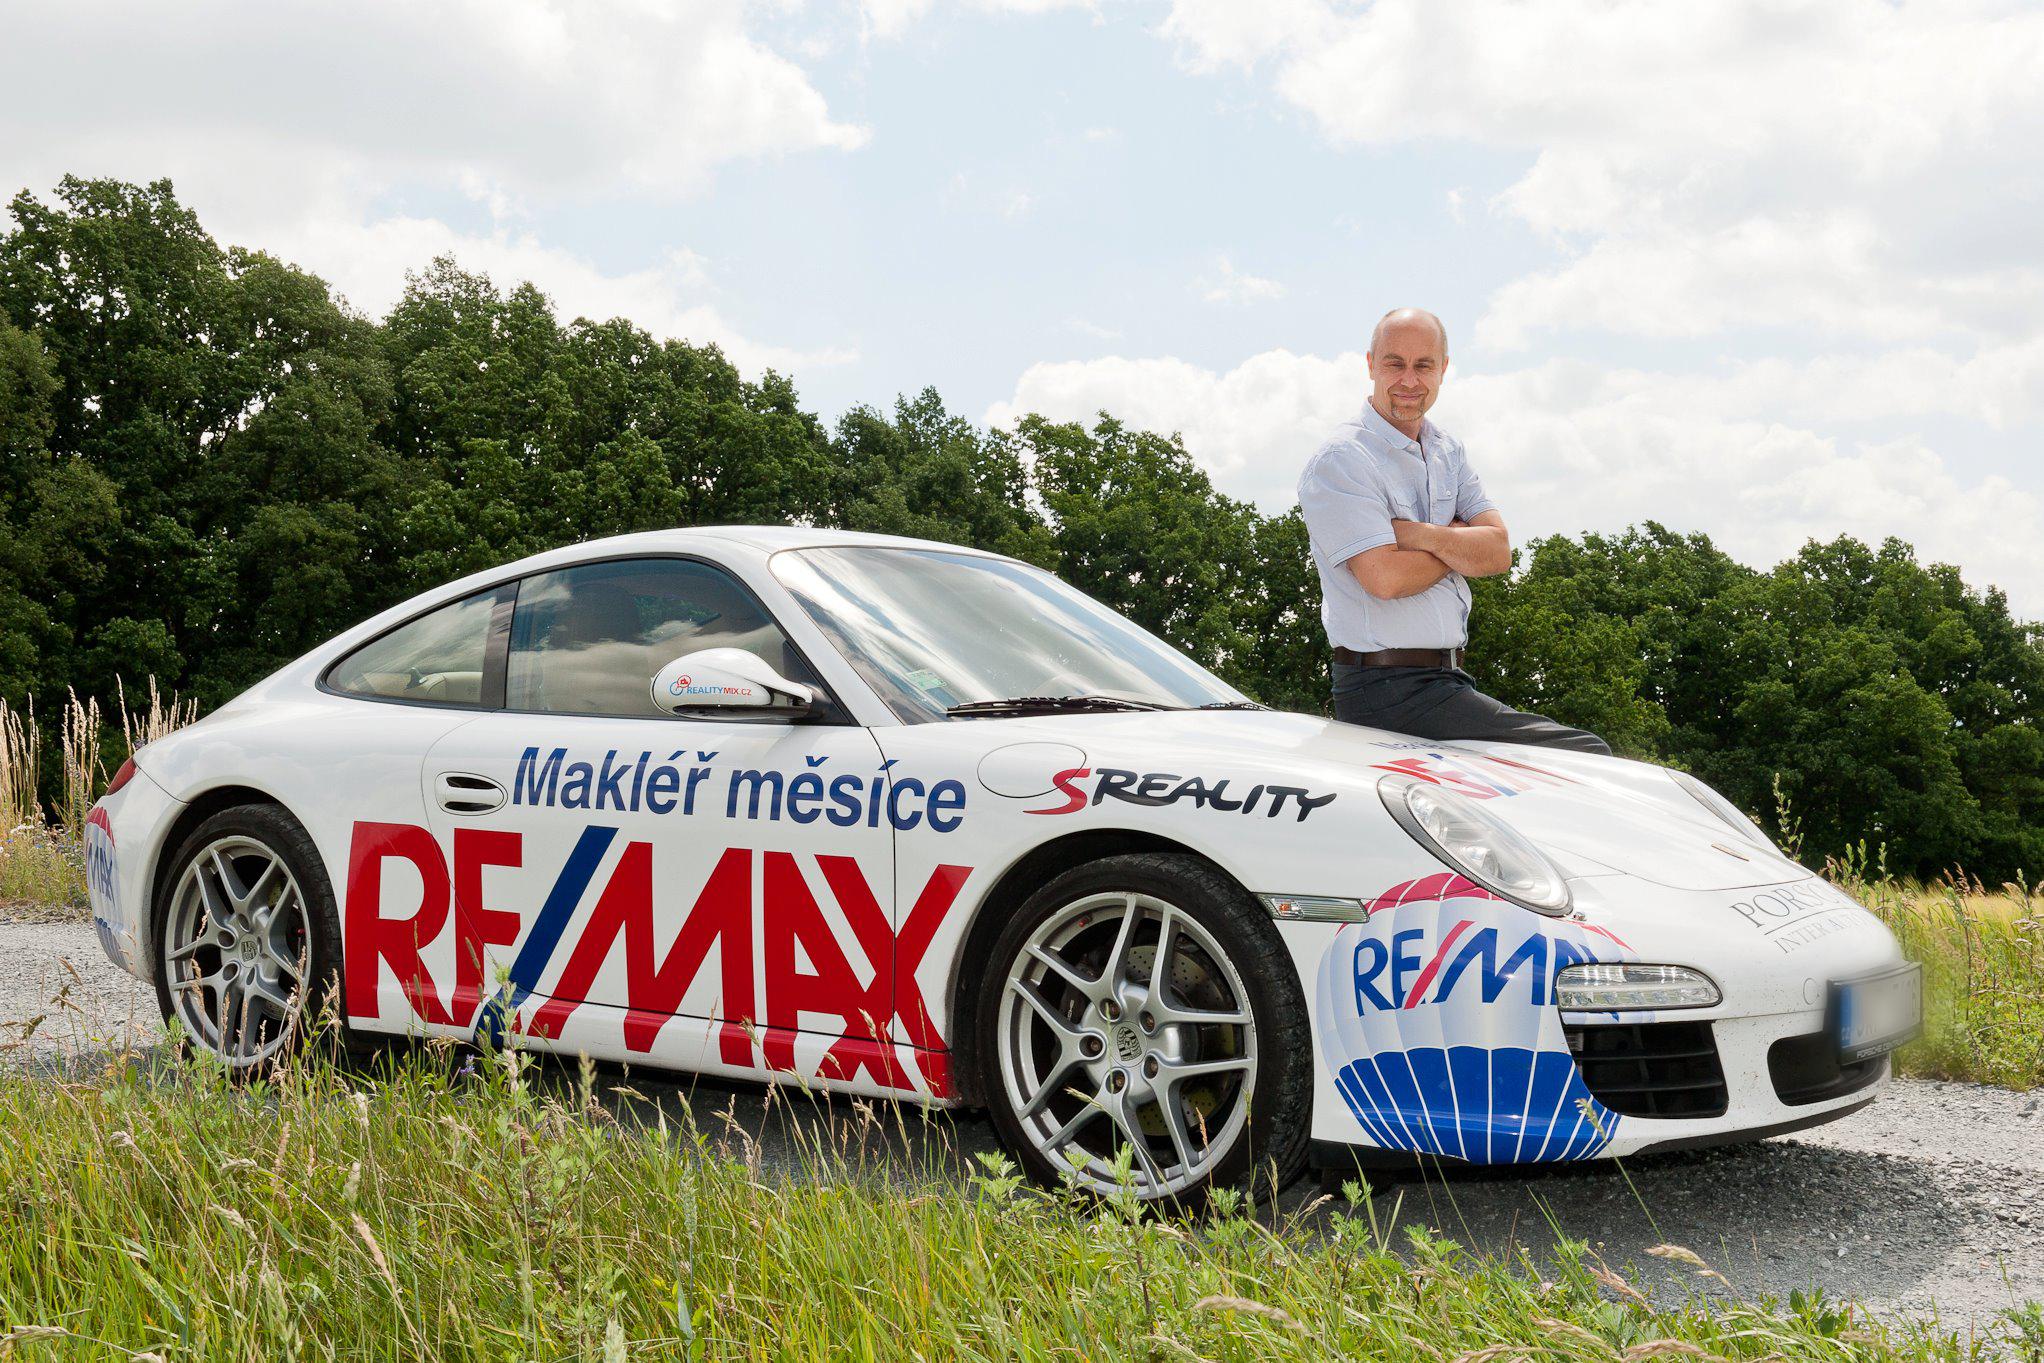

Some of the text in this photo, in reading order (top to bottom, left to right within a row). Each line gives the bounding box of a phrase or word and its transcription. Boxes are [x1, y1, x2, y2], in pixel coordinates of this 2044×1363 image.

[513, 746, 967, 833] Makléř měsíce
[1023, 767, 1338, 823] SREALITY
[344, 821, 974, 1100] RE/MAX
[1354, 920, 1621, 1022] RE/MA
